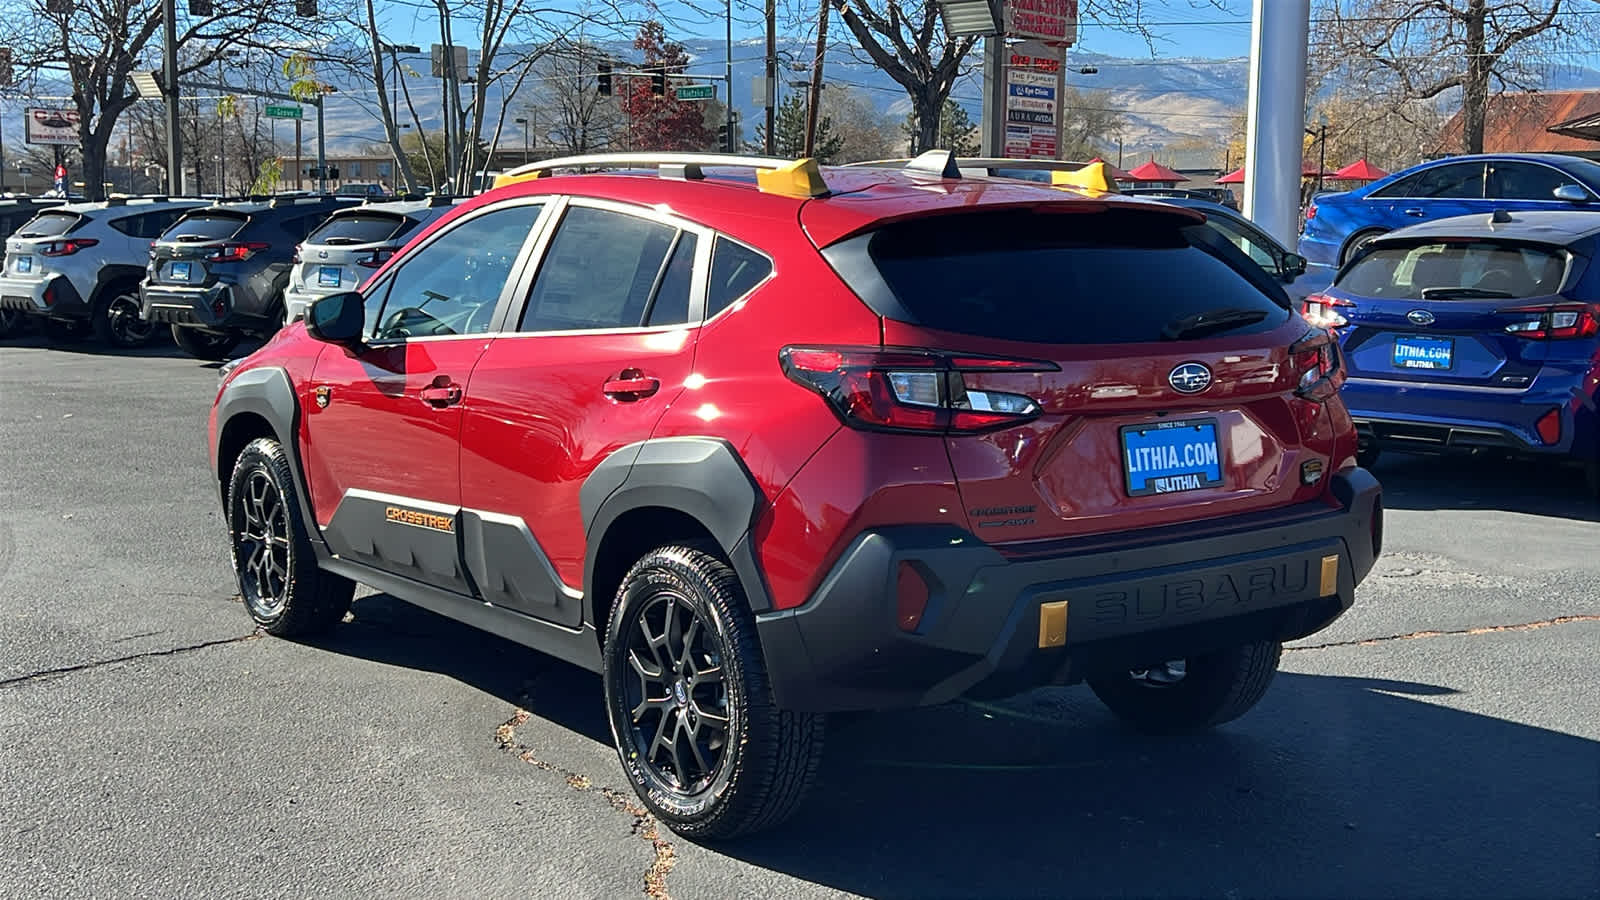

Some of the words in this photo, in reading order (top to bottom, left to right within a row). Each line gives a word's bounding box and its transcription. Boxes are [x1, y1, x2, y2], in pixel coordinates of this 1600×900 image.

[1024, 87, 1034, 97] Eye
[1034, 88, 1049, 97] Clinic
[1395, 344, 1451, 360] LITHIA.COM
[1413, 360, 1434, 369] LITHIA
[1127, 441, 1218, 473] LITHIA.COM
[1165, 474, 1201, 492] LITHIA
[385, 507, 453, 531] CROSSTREK
[1093, 561, 1309, 623] SUBARU
